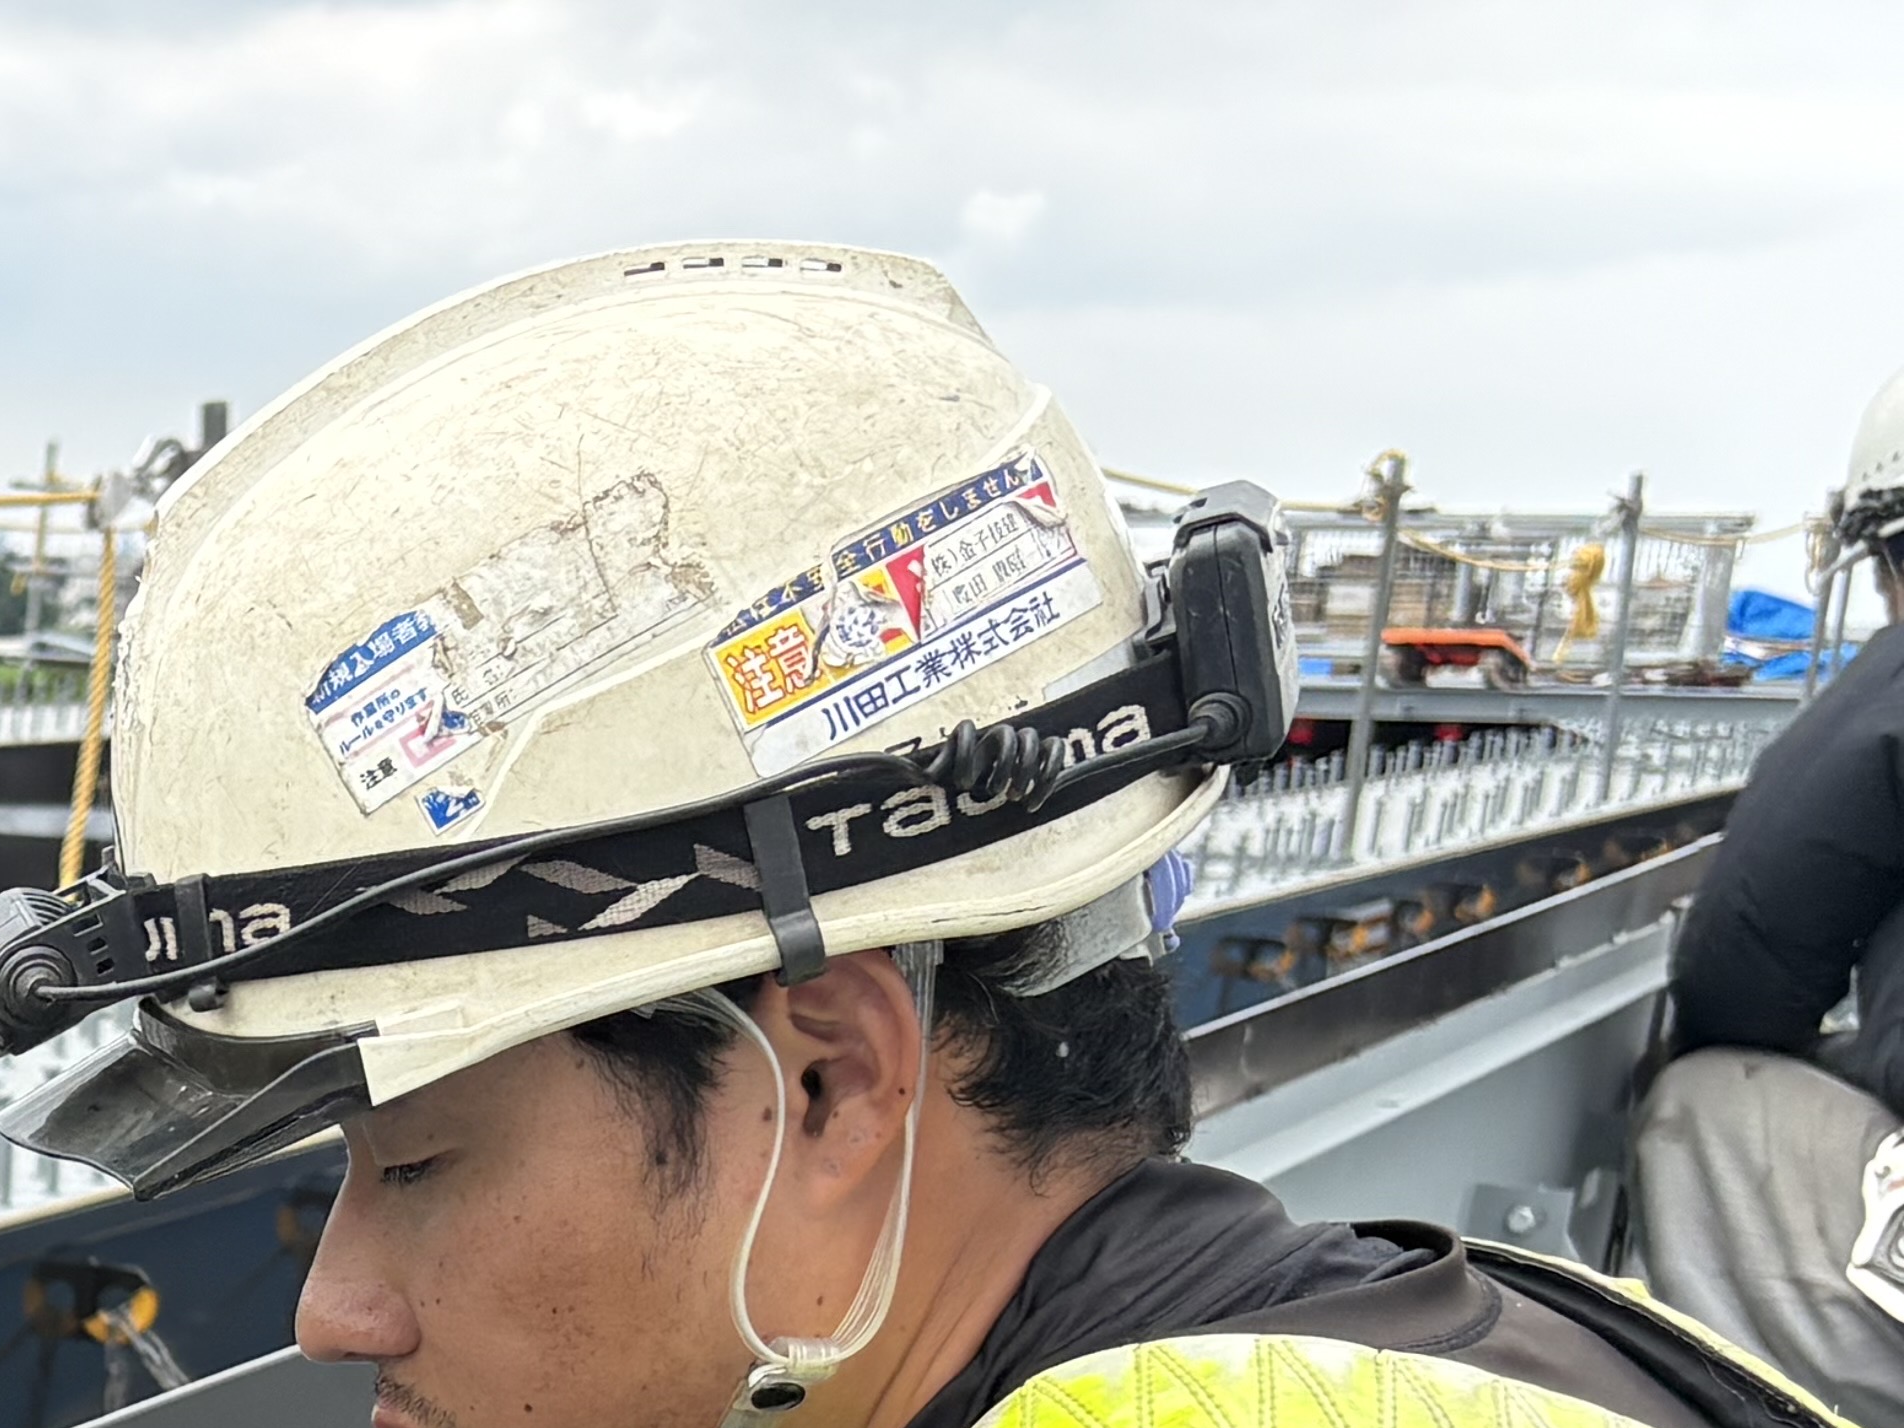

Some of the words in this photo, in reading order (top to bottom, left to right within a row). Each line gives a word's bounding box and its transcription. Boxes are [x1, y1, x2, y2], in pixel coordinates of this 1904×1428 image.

[726, 625, 823, 713] 注意
[822, 591, 1060, 740] 川田工業株式会社
